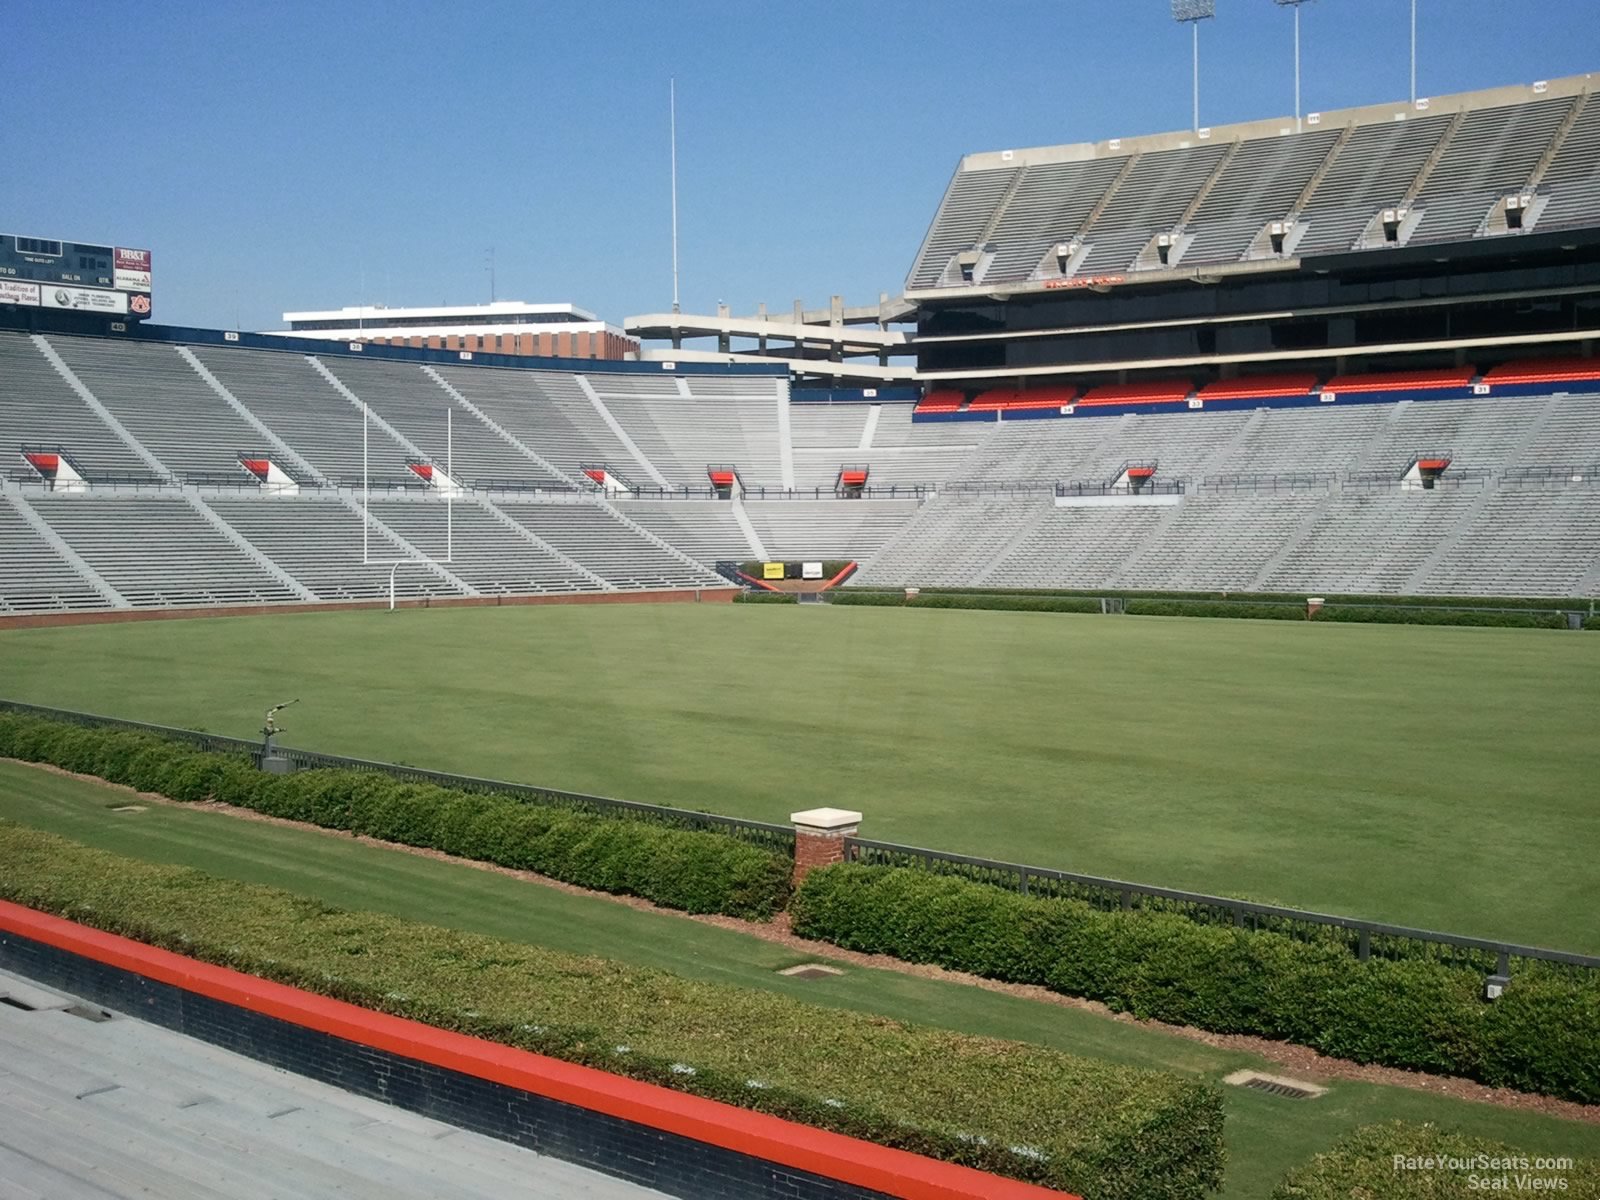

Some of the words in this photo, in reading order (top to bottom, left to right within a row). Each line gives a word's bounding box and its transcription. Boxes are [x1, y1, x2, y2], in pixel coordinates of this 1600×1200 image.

[120, 249, 144, 260] BB&T
[7, 267, 17, 275] GO
[4, 283, 29, 292] Tradition
